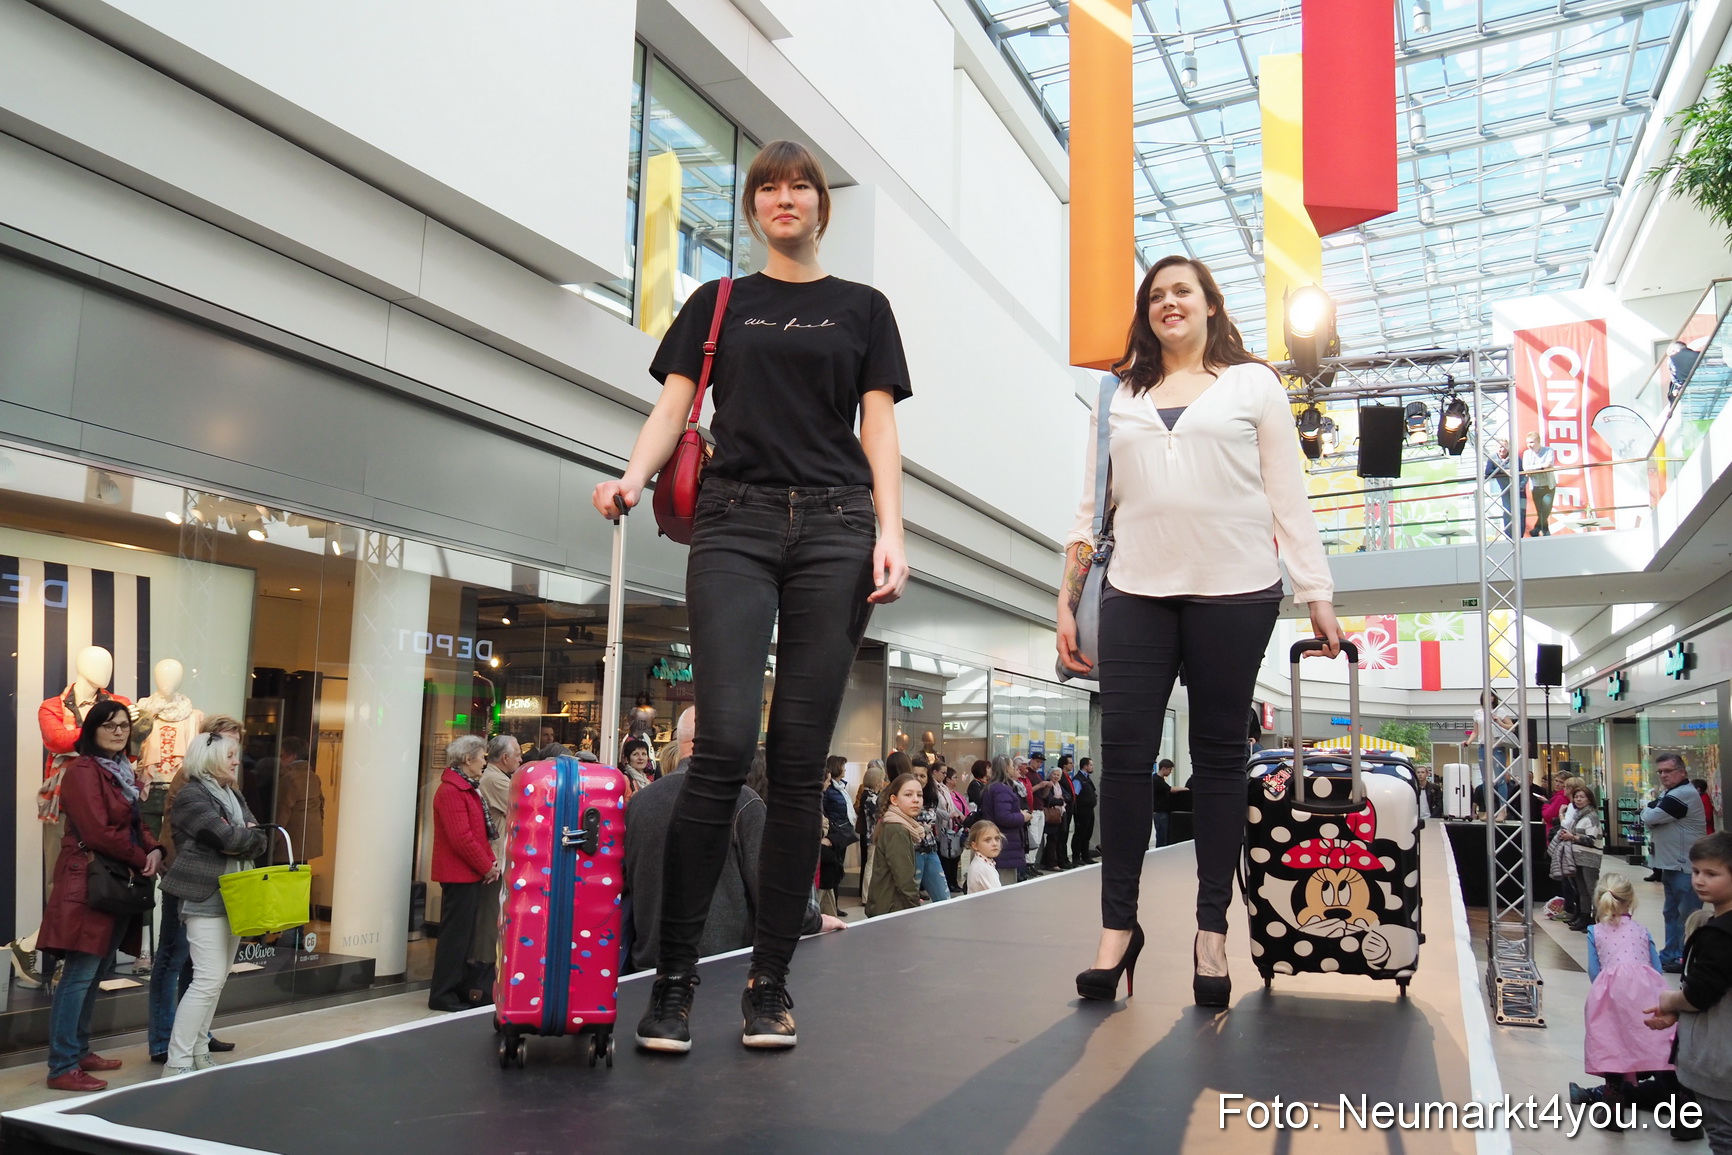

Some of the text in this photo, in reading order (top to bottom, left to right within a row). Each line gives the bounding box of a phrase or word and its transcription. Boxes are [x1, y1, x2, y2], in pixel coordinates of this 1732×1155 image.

[1538, 345, 1582, 536] CINEPLEX
[307, 937, 315, 947] CG
[238, 943, 276, 961] s.Oliver
